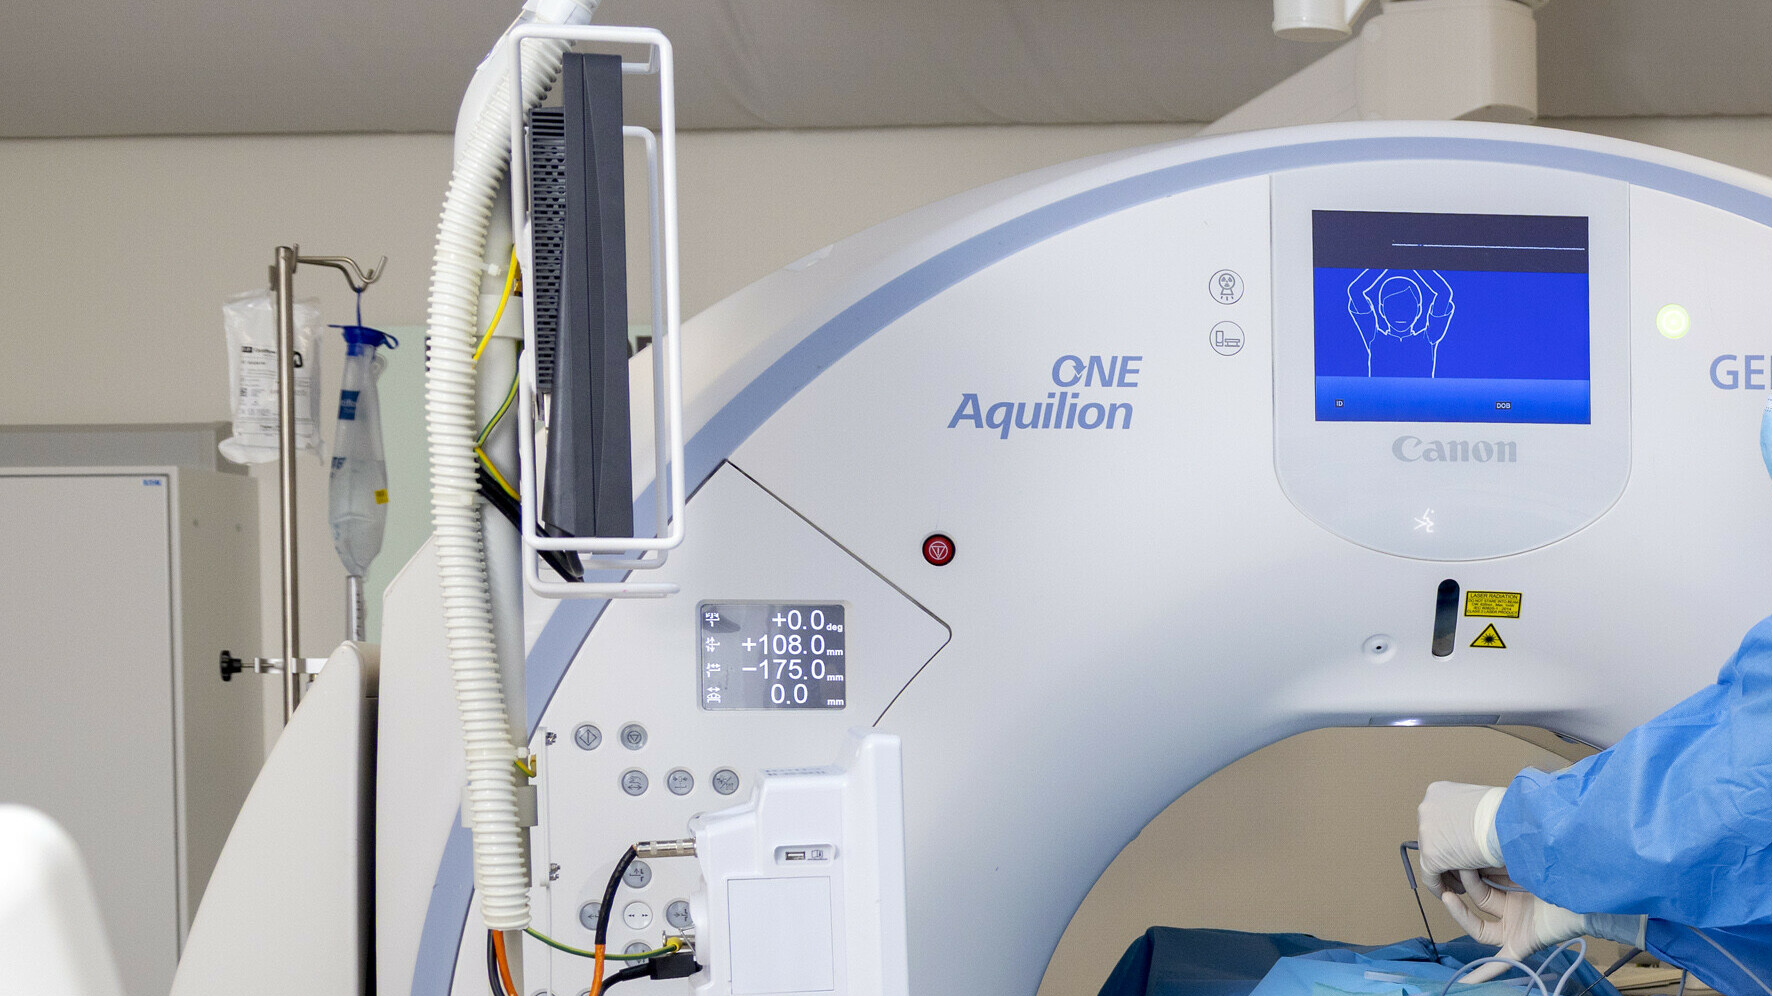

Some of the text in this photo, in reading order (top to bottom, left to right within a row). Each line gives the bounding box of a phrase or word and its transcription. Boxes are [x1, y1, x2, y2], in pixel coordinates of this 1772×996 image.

[1052, 355, 1143, 388] ONE
[947, 391, 1134, 440] Aquilion
[1391, 435, 1517, 463] Canon
[771, 609, 843, 632] +0.0 deg
[741, 634, 825, 655] +108.0
[741, 659, 826, 680] -175.0
[770, 683, 808, 704] 0.0
